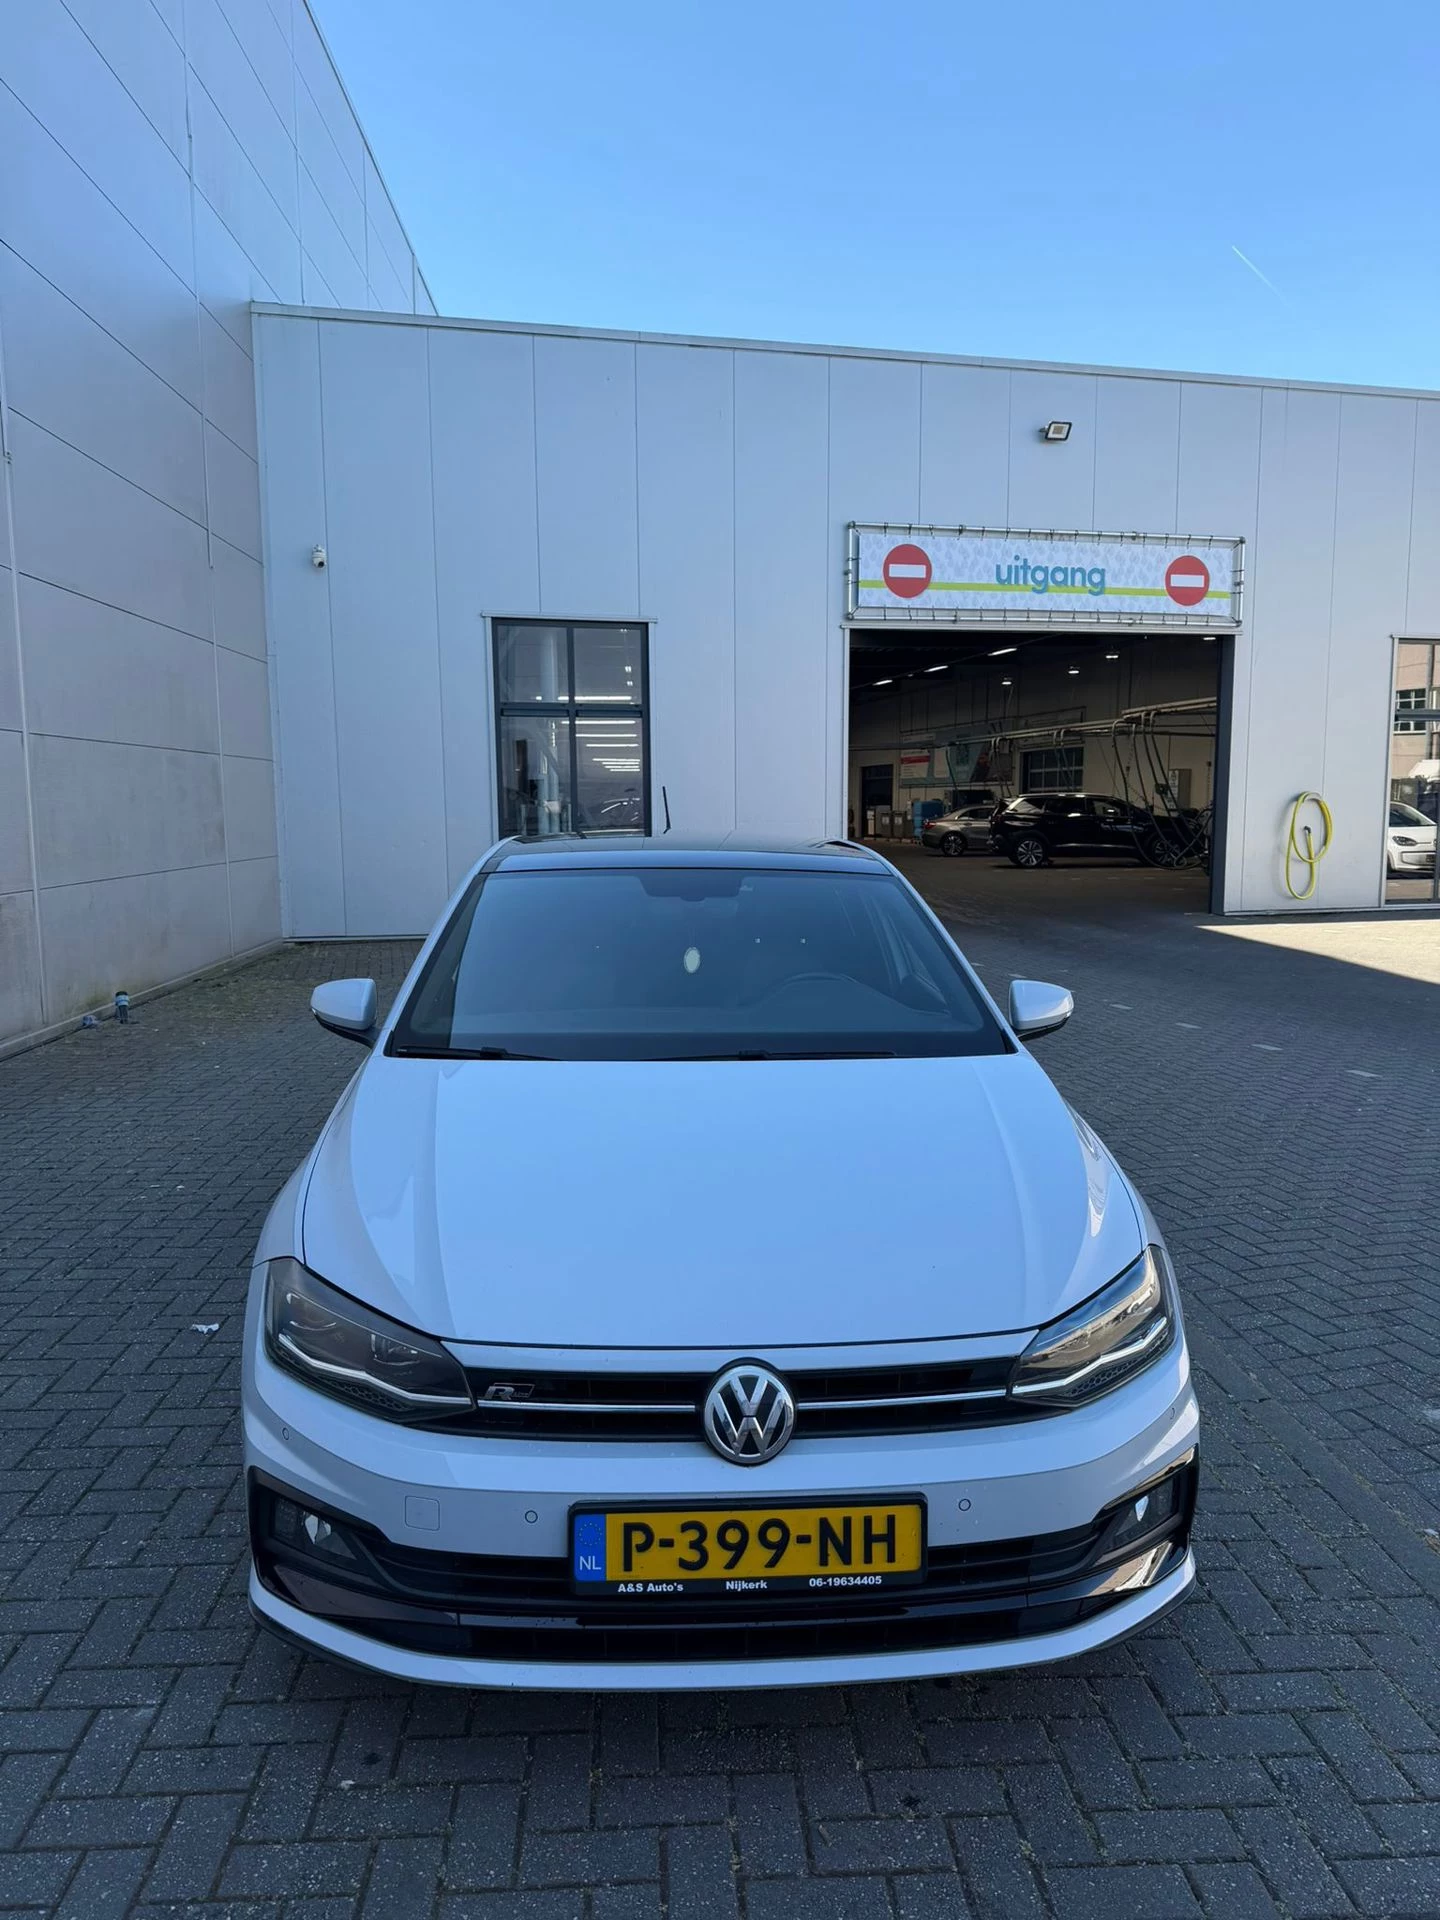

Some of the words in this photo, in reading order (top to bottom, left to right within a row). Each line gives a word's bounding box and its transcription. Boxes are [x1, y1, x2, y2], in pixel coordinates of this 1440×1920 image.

[995, 554, 1106, 596] uitgang
[621, 1513, 896, 1573] P-399-NH
[578, 1554, 602, 1571] NL
[617, 1582, 644, 1593] A&S
[646, 1582, 684, 1592] Auto's
[725, 1580, 768, 1591] Nijkerk
[808, 1575, 883, 1588] 06-19634405
